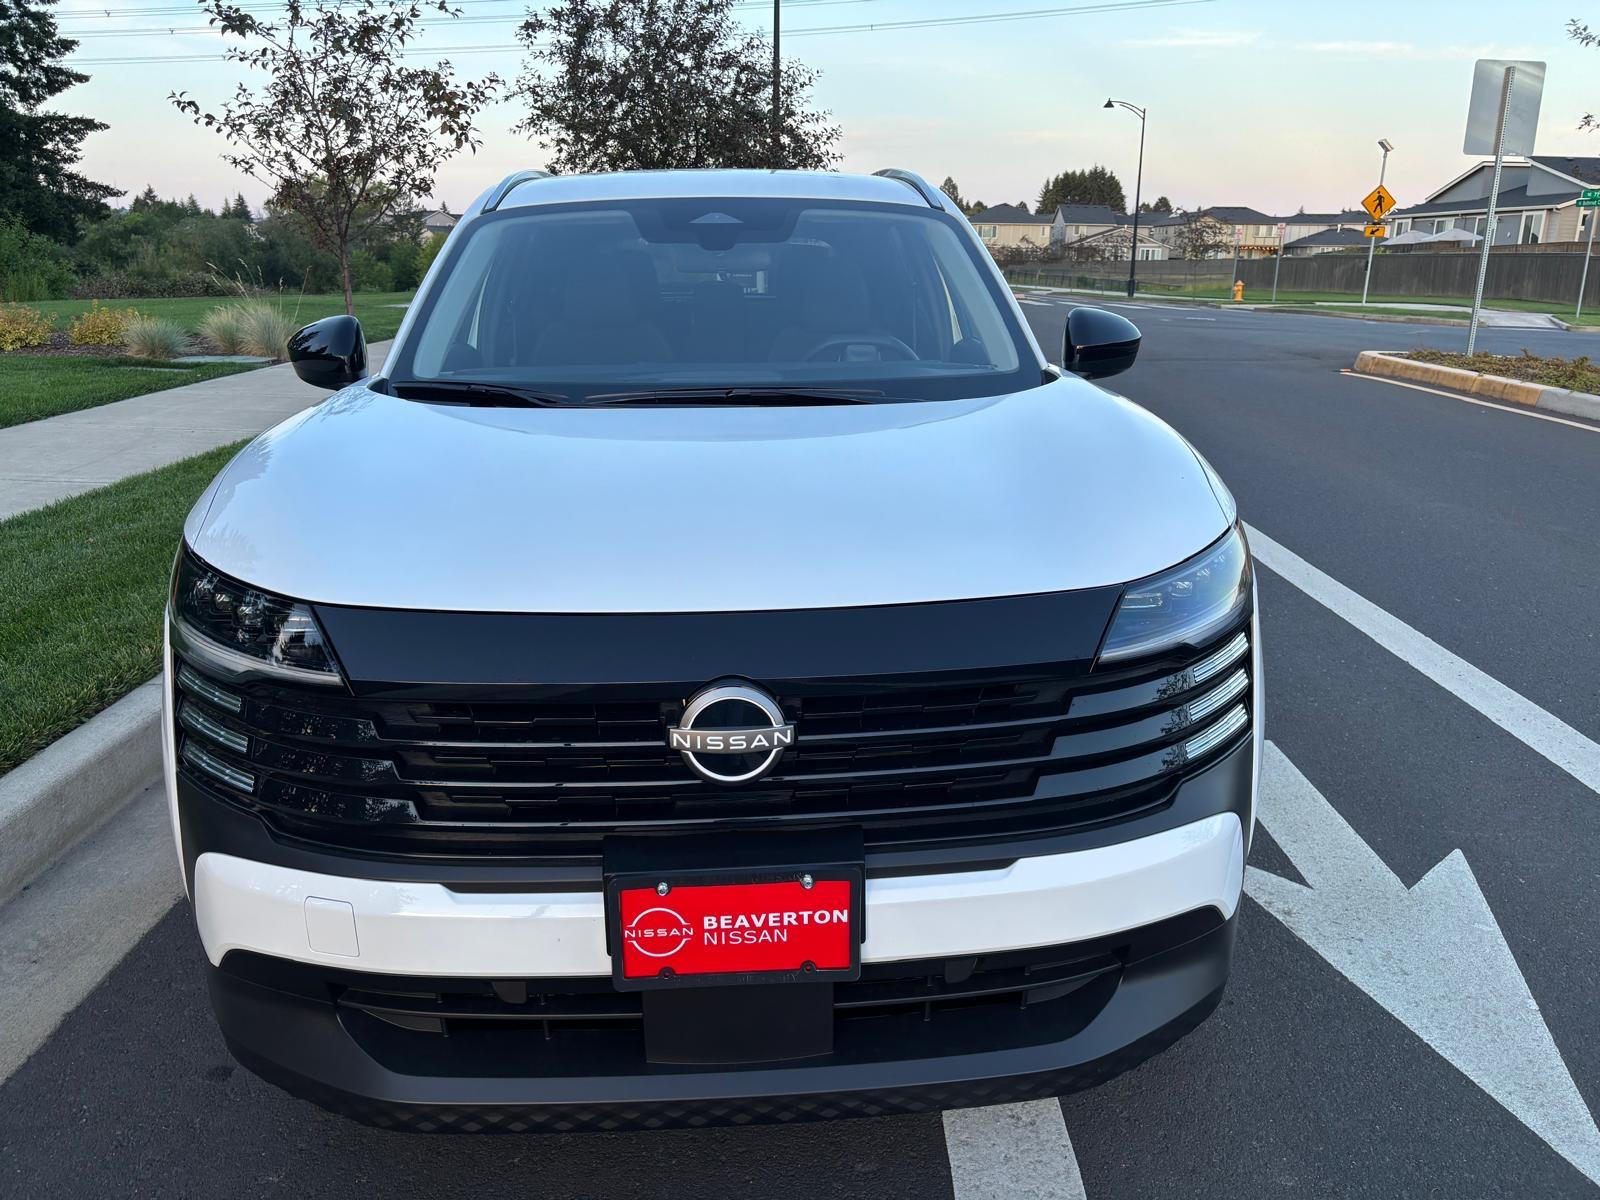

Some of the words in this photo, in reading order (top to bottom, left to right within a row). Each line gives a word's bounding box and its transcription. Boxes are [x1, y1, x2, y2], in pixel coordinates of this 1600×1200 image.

[673, 730, 791, 750] NISSAN
[703, 909, 848, 929] BEAVERTON
[625, 927, 694, 938] NISSAN
[704, 929, 788, 945] NISSAN
